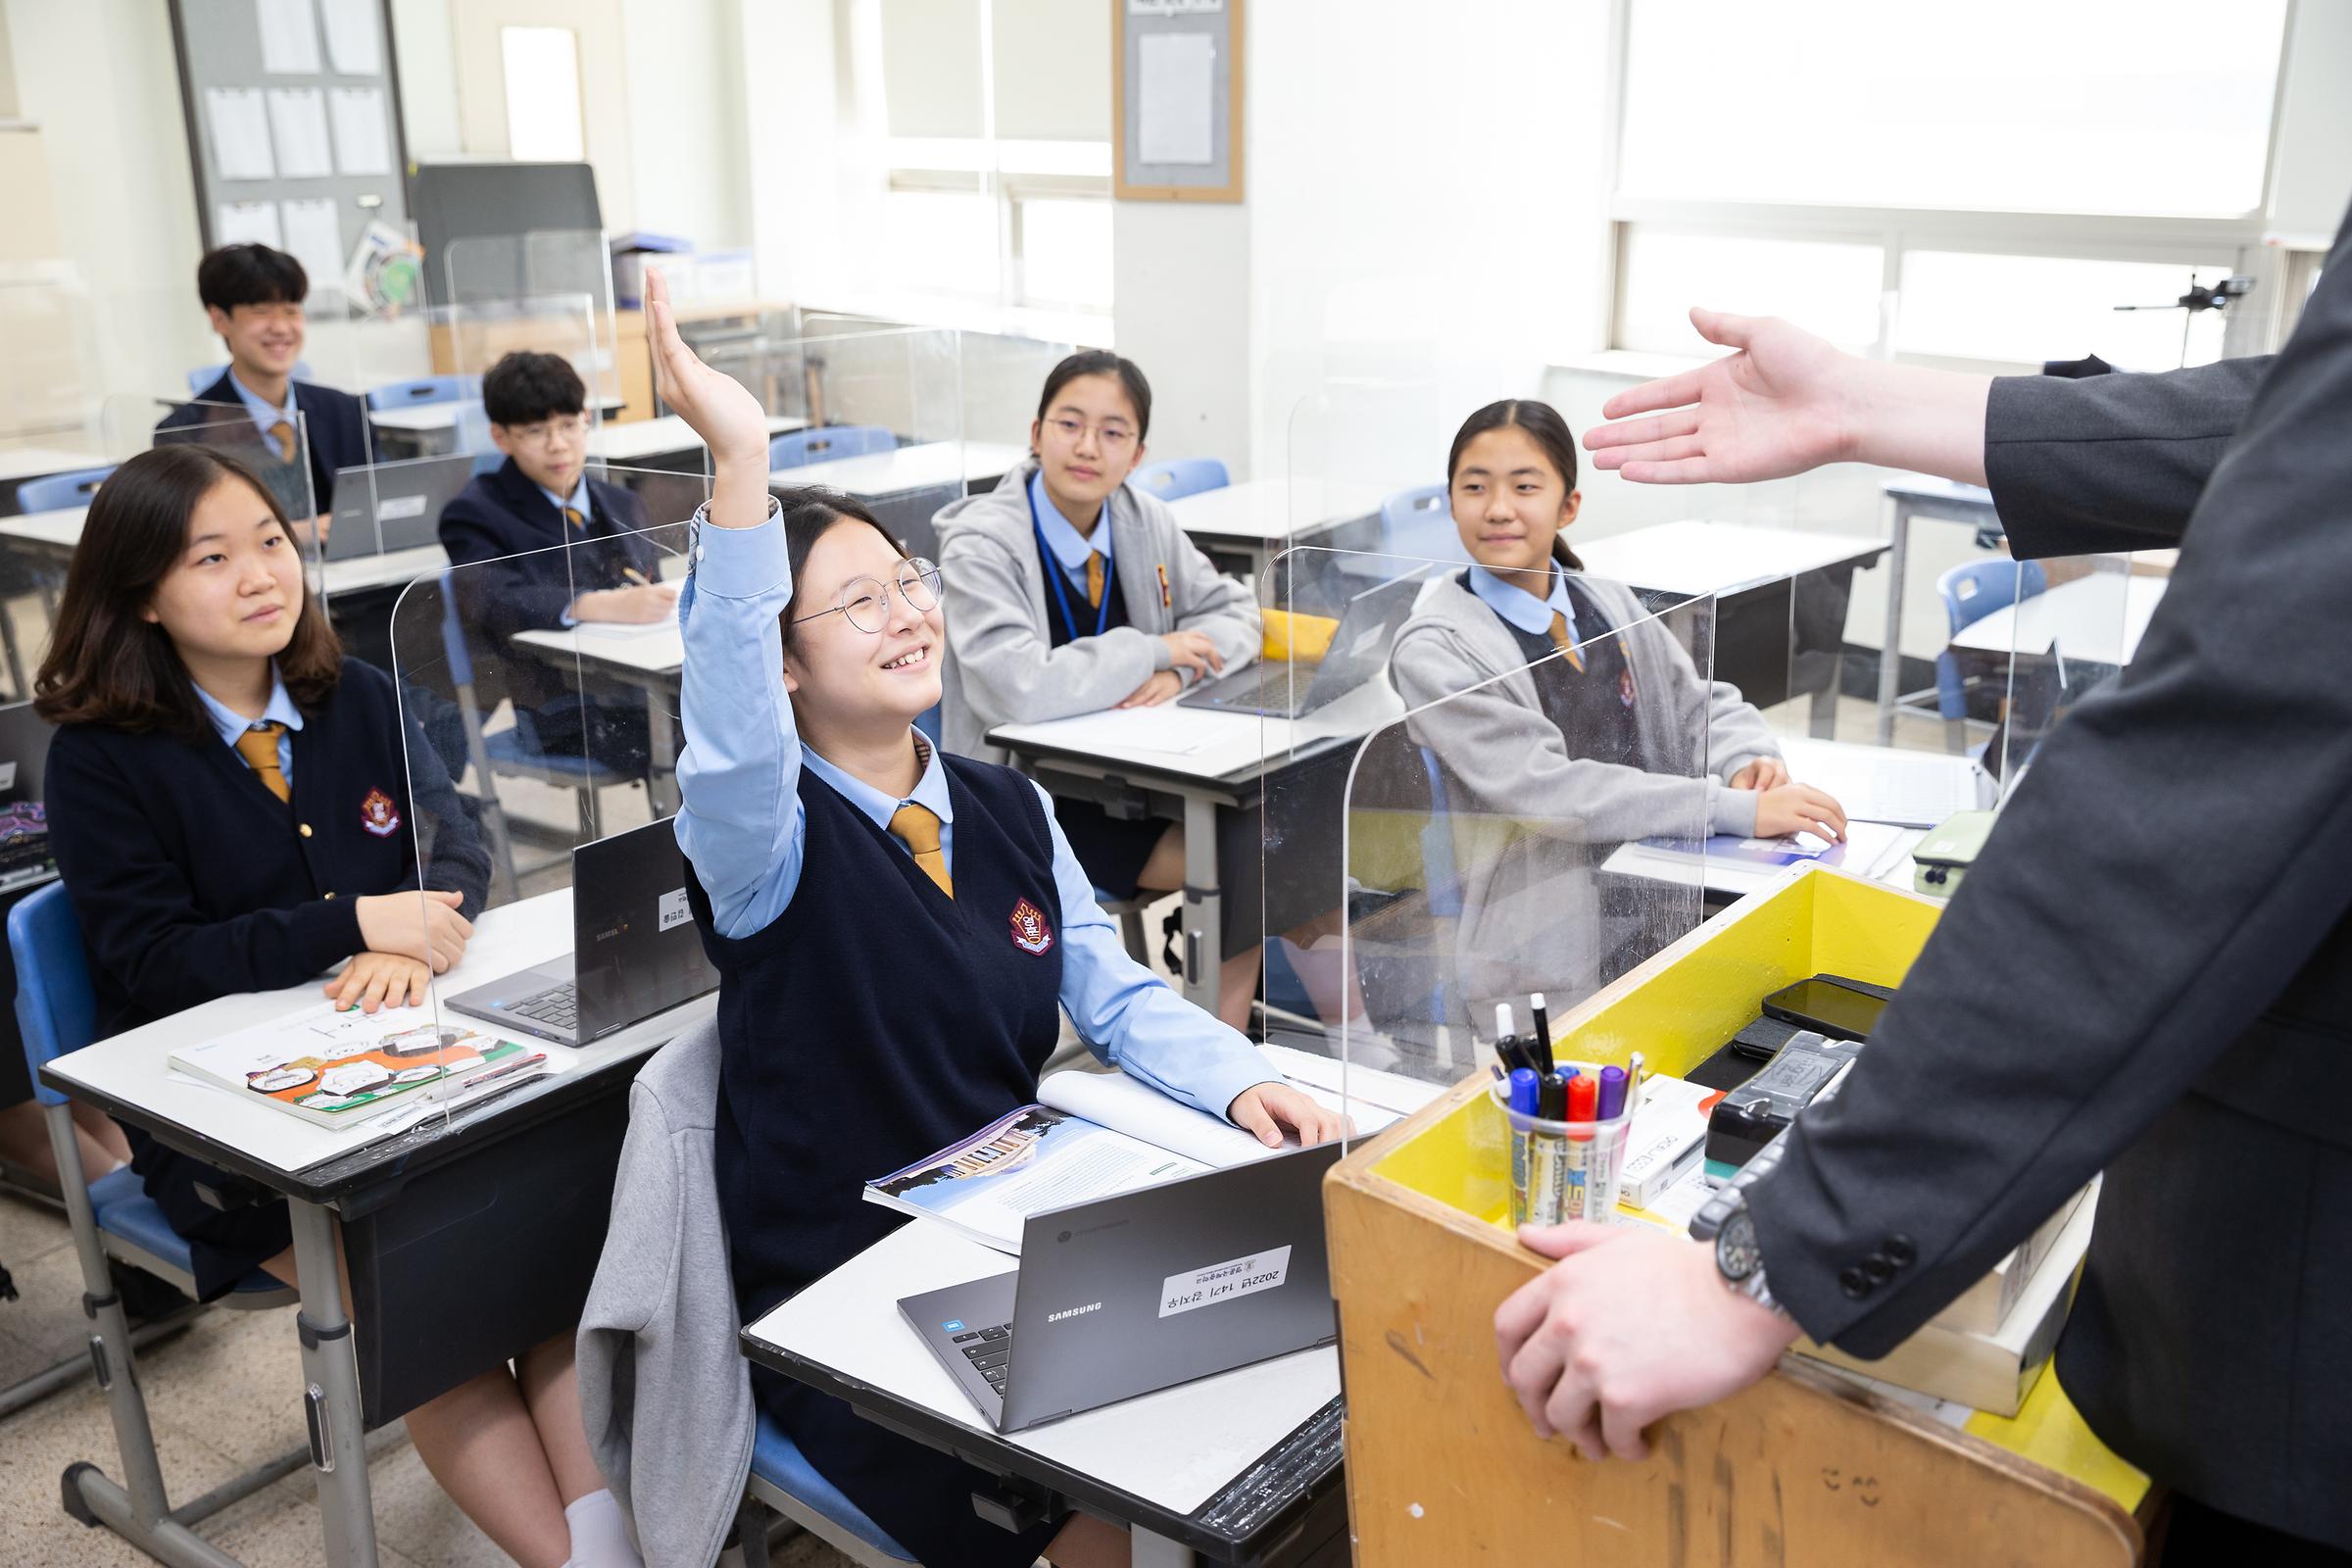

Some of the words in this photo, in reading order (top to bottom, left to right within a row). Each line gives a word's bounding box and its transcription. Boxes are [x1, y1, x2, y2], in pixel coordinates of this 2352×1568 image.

[596, 923, 628, 942] SAMSU
[1241, 1270, 1280, 1290] 2022년
[1167, 1291, 1202, 1308] 강지우
[1209, 1283, 1235, 1298] 14기
[1048, 1301, 1102, 1323] SAMSUNG
